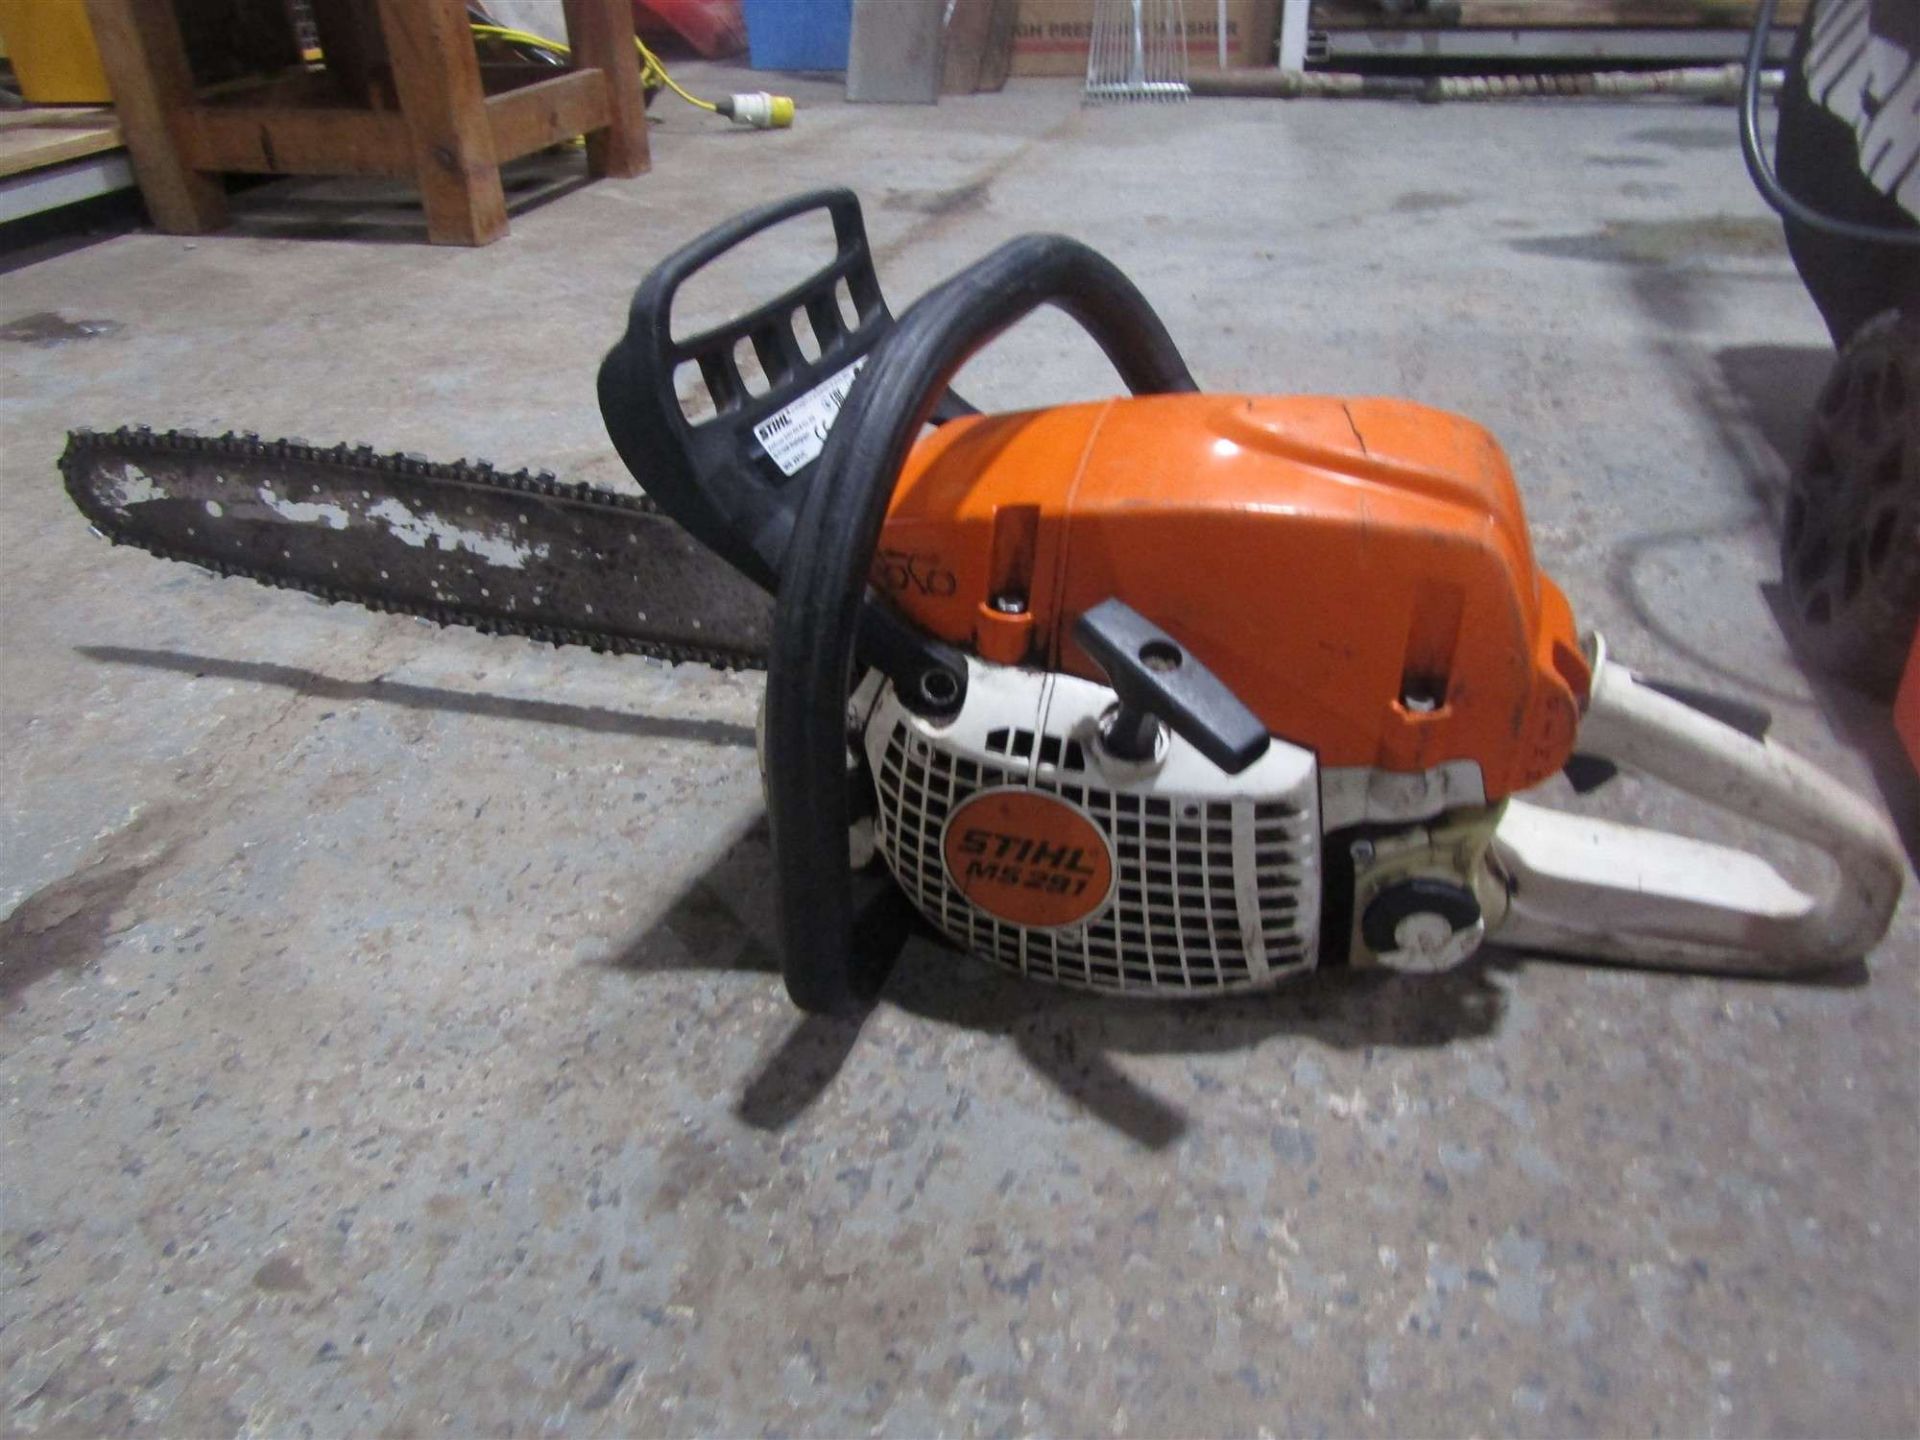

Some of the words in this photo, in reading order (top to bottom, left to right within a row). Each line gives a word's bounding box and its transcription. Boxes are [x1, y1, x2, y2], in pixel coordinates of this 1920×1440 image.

[758, 412, 792, 441] STIHL
[958, 828, 1094, 875] STIHL
[965, 860, 1020, 887] MS
[1023, 868, 1088, 897] 291
